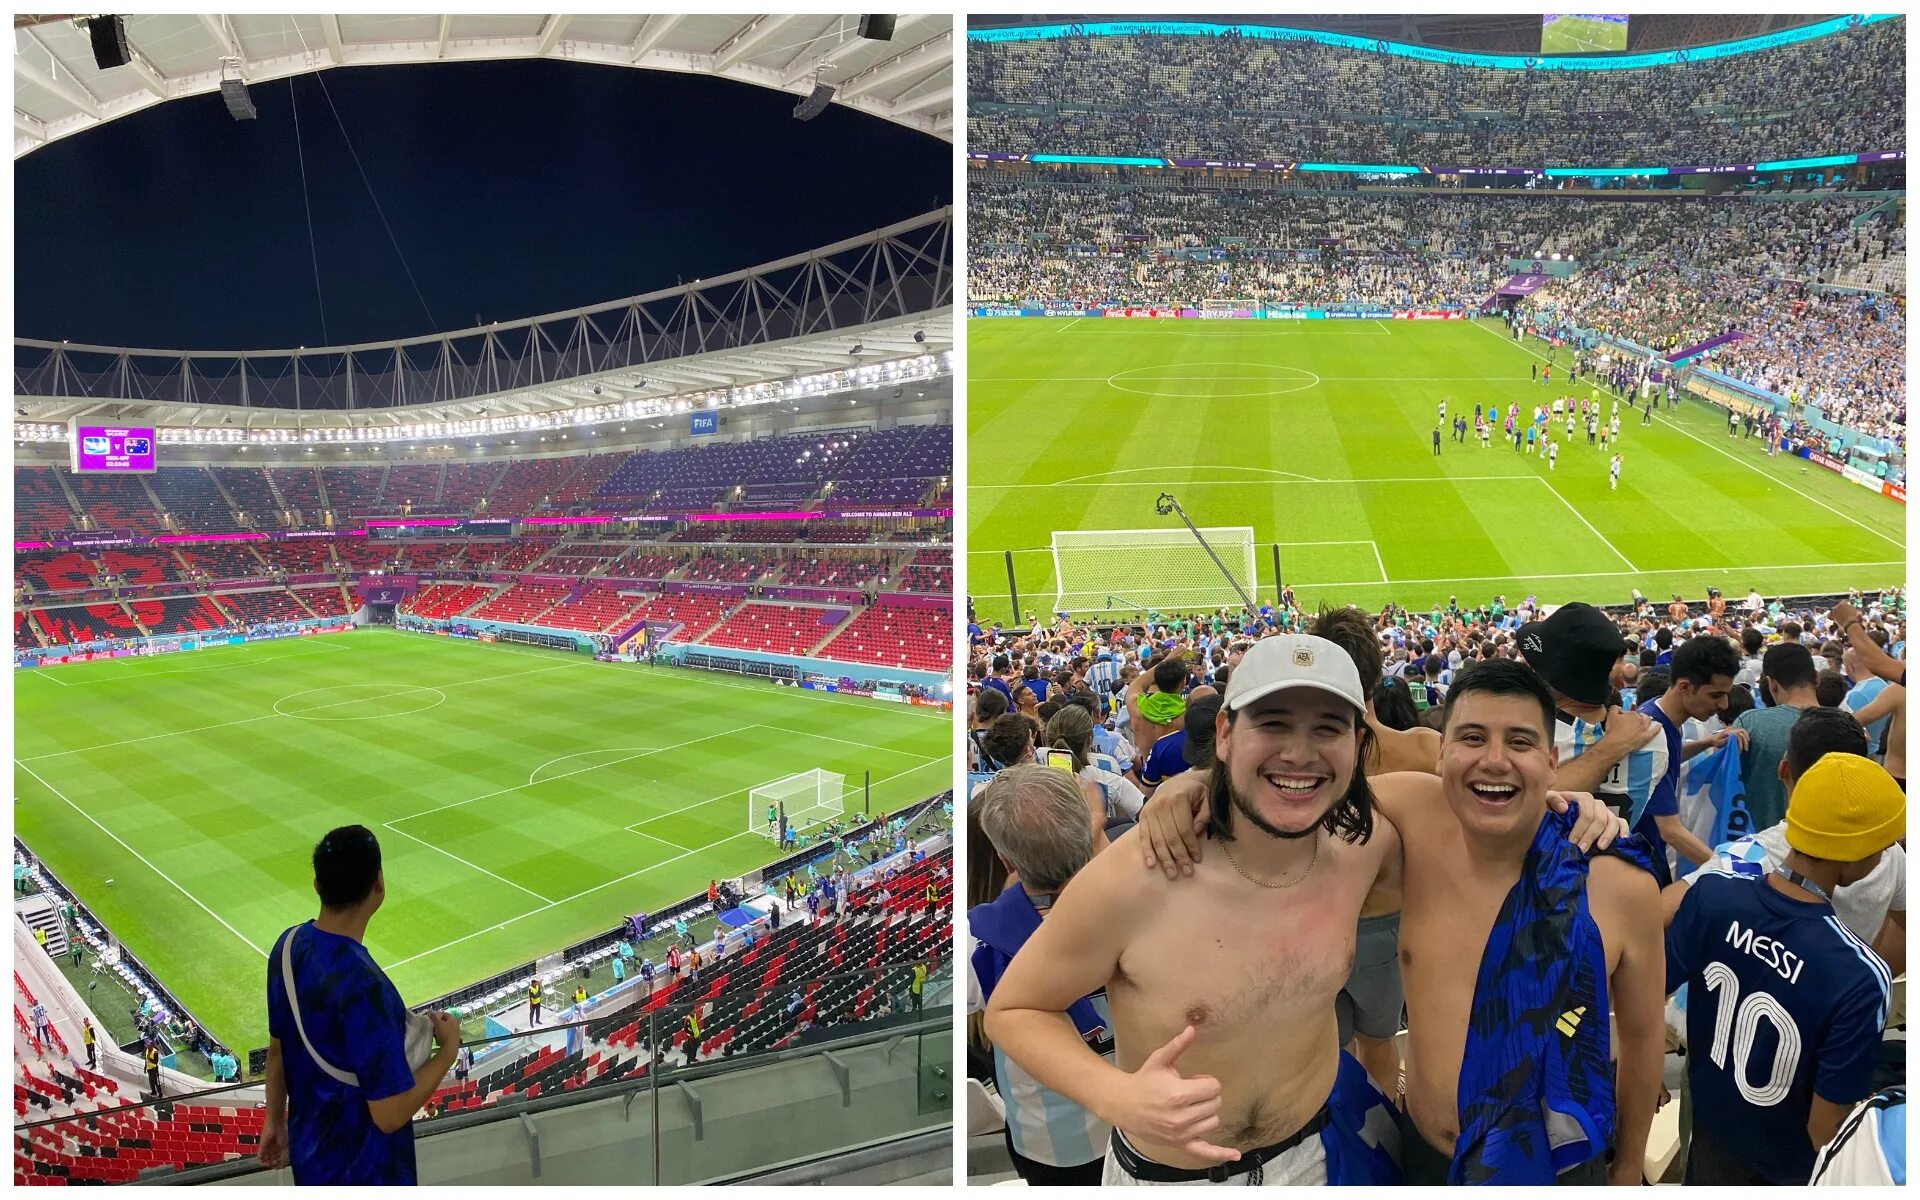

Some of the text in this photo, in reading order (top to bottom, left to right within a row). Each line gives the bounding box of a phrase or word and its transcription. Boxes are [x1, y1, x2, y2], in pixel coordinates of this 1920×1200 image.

[694, 418, 713, 429] FIFA
[1808, 451, 1825, 464] QATAR
[813, 683, 828, 691] VISA
[1098, 678, 1111, 693] 10
[1725, 920, 1804, 985] MESSI
[1702, 961, 1802, 1107] 10
